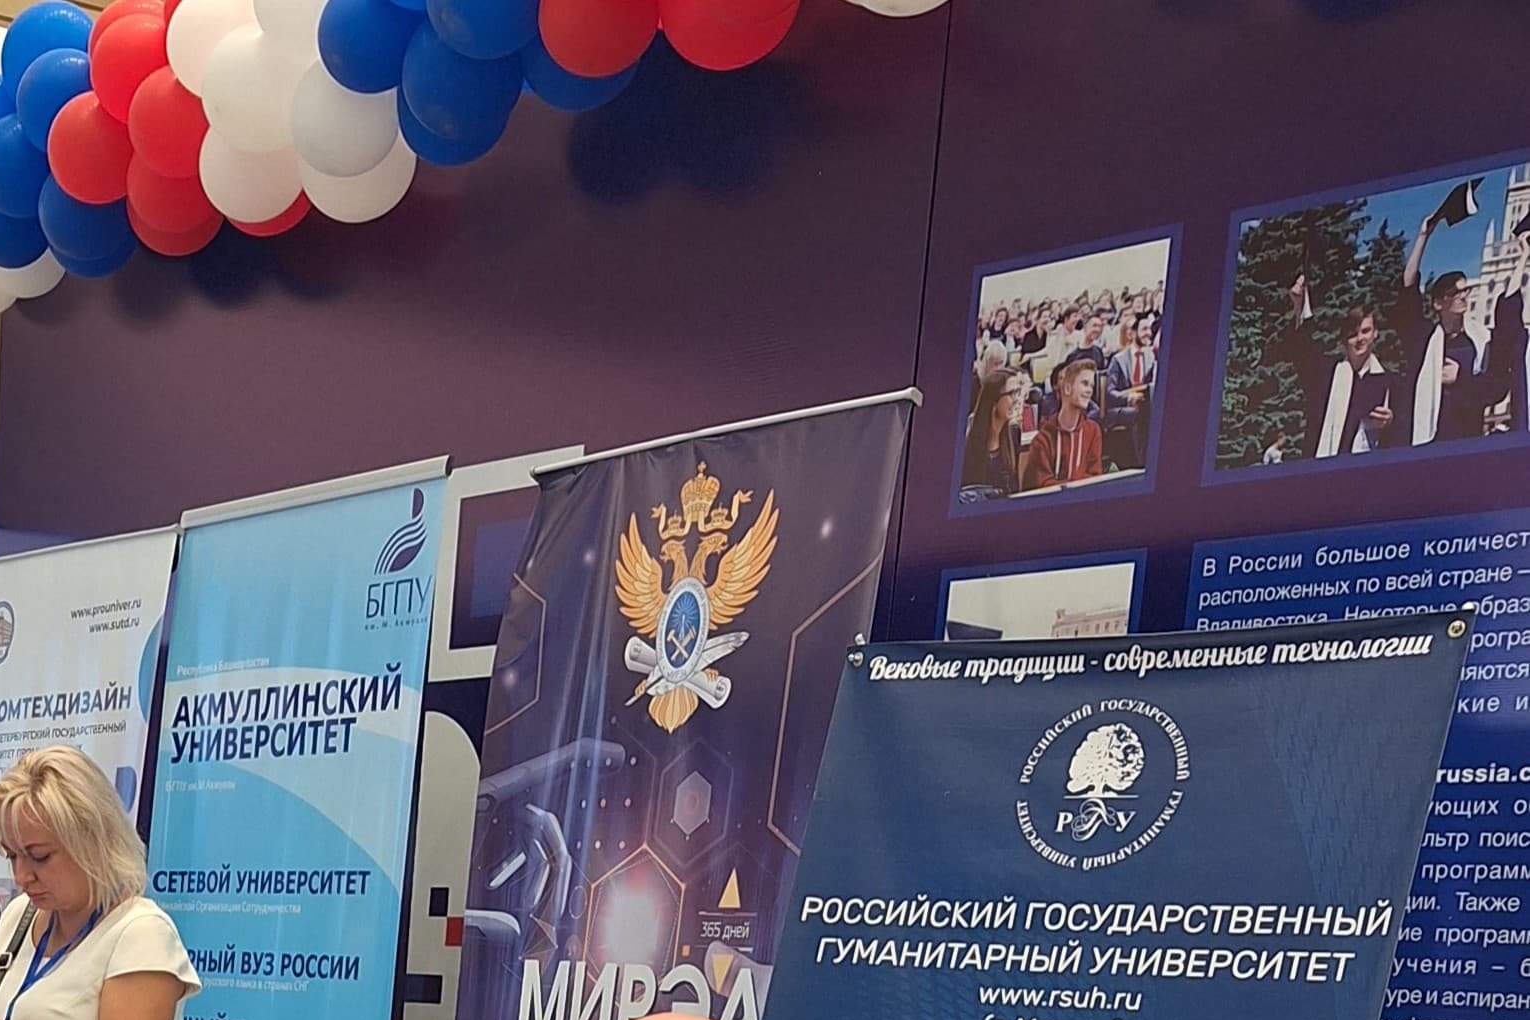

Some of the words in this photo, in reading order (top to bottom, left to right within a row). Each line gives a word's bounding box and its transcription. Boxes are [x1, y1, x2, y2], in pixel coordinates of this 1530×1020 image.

[1202, 558, 1216, 577] В
[1228, 552, 1303, 575] России
[1315, 541, 1411, 567] большое
[365, 574, 433, 619] БГПУ
[1199, 579, 1350, 611] расположенных
[1355, 577, 1380, 593] по
[1385, 570, 1434, 590] всей
[1438, 564, 1513, 590] стране
[70, 598, 142, 620] www.prouniver.ru
[1473, 595, 1530, 619] браз
[89, 616, 139, 634] www.sutd.ru
[870, 654, 959, 680] Вековые
[964, 653, 1085, 684] традиции
[1104, 642, 1268, 678] современные
[1272, 634, 1434, 664] технологии
[172, 662, 402, 729] АКМУЛЛИНСКИЙ
[51, 720, 127, 738] ГОСУДАРСТВЕННЫЙ
[171, 718, 356, 764] УНИВЕРСИТЕТ
[1019, 703, 1093, 784] РОССИЙСКИЙ
[1100, 698, 1191, 781] ГОСУДАРСТВЕННЫЙ
[1016, 800, 1078, 869] УНИВЕРСИТЕТ
[1082, 790, 1184, 871] ГУМАНИТАРНЫЙ
[152, 863, 231, 894] СЕТЕВОЙ
[235, 870, 371, 896] УНИВЕРСИТЕТ
[800, 894, 1018, 929] РОССИЙСКИЙ
[1024, 899, 1394, 936] ГОСУДАРСТВЕННЫЙ
[1455, 891, 1521, 912] Также
[700, 921, 721, 937] 365
[721, 921, 750, 941] дней
[1435, 926, 1530, 948] програм
[241, 951, 274, 976] ВУЗ
[280, 953, 360, 981] РОССИИ
[816, 937, 1083, 974] ГУМАНИТАРНЫЙ
[1088, 947, 1355, 982] УНИВЕРСИТЕТ
[978, 985, 1142, 1011] www.rsuh.ru
[1425, 989, 1438, 1004] и
